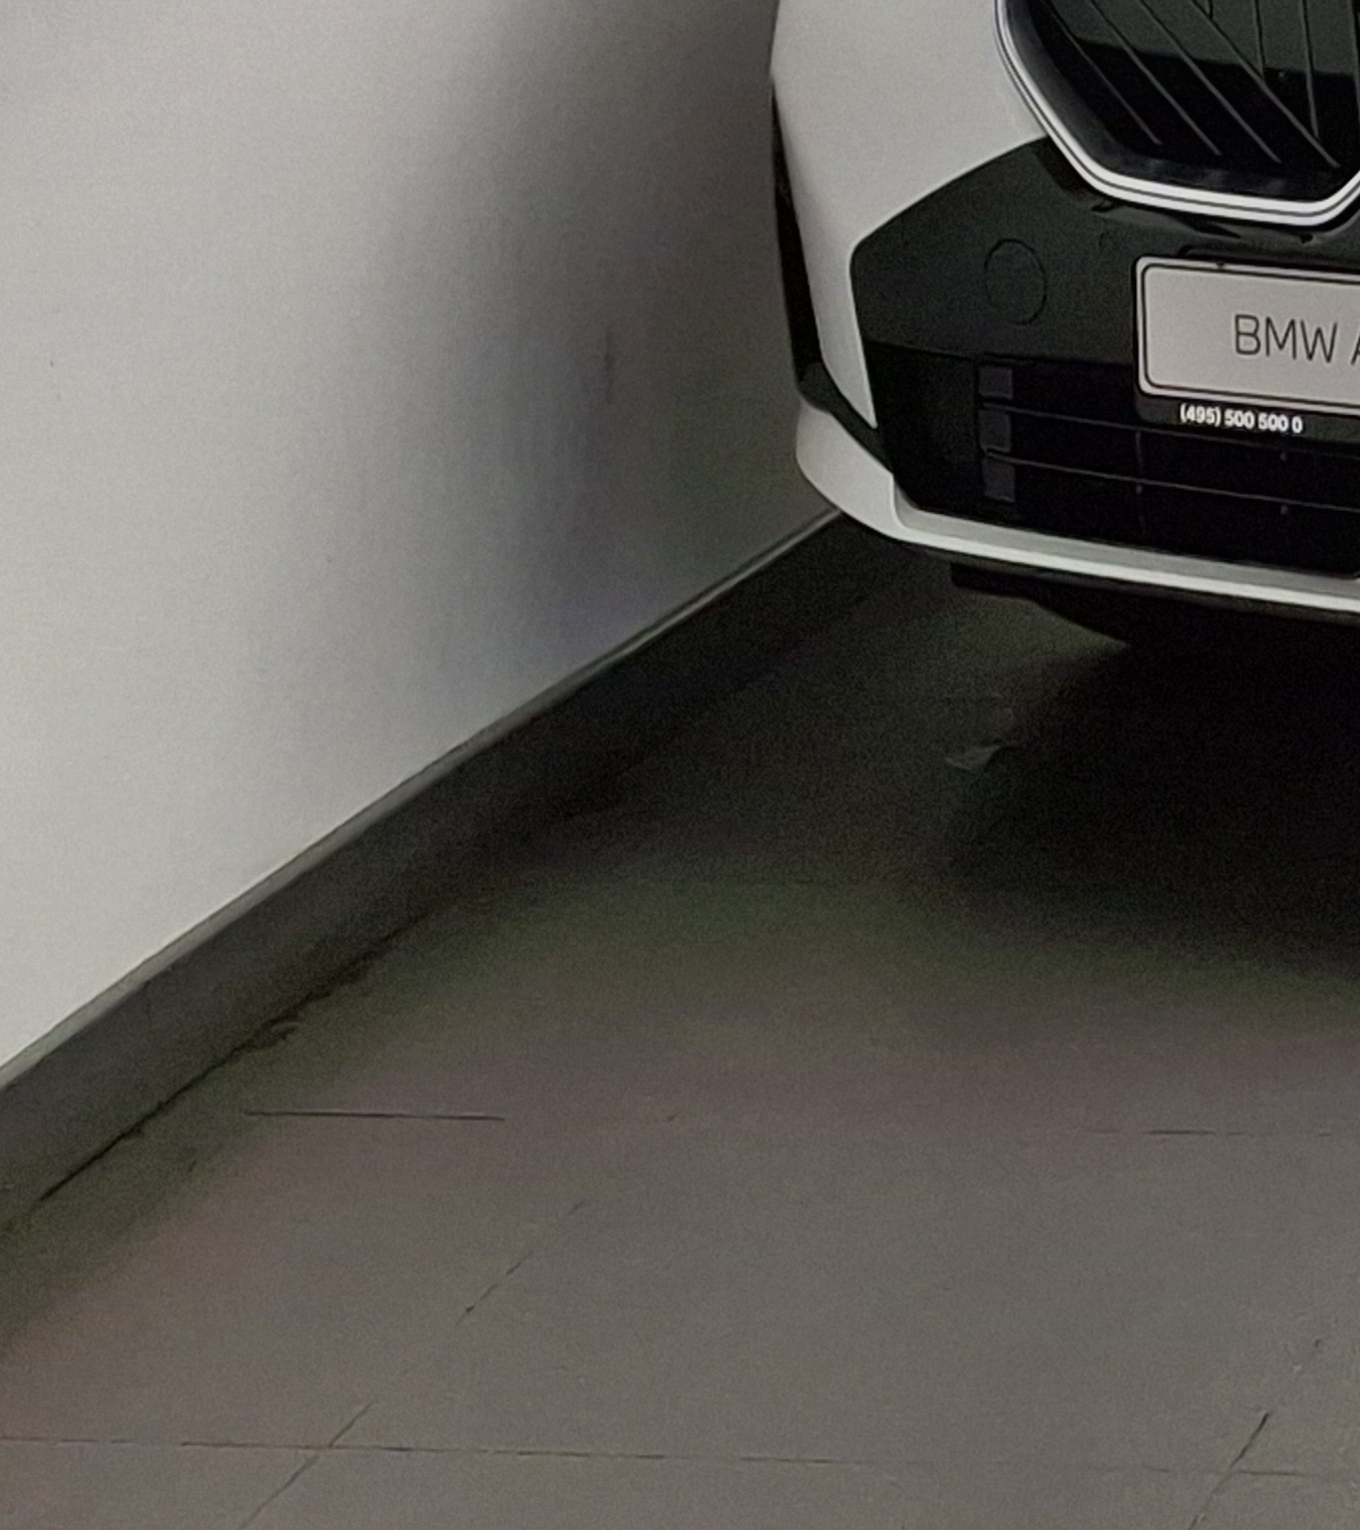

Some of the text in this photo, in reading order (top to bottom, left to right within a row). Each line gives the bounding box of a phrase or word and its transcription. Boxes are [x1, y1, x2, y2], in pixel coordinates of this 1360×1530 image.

[1234, 313, 1338, 364] BMW
[1180, 402, 1304, 434] (495) 500 500 0
